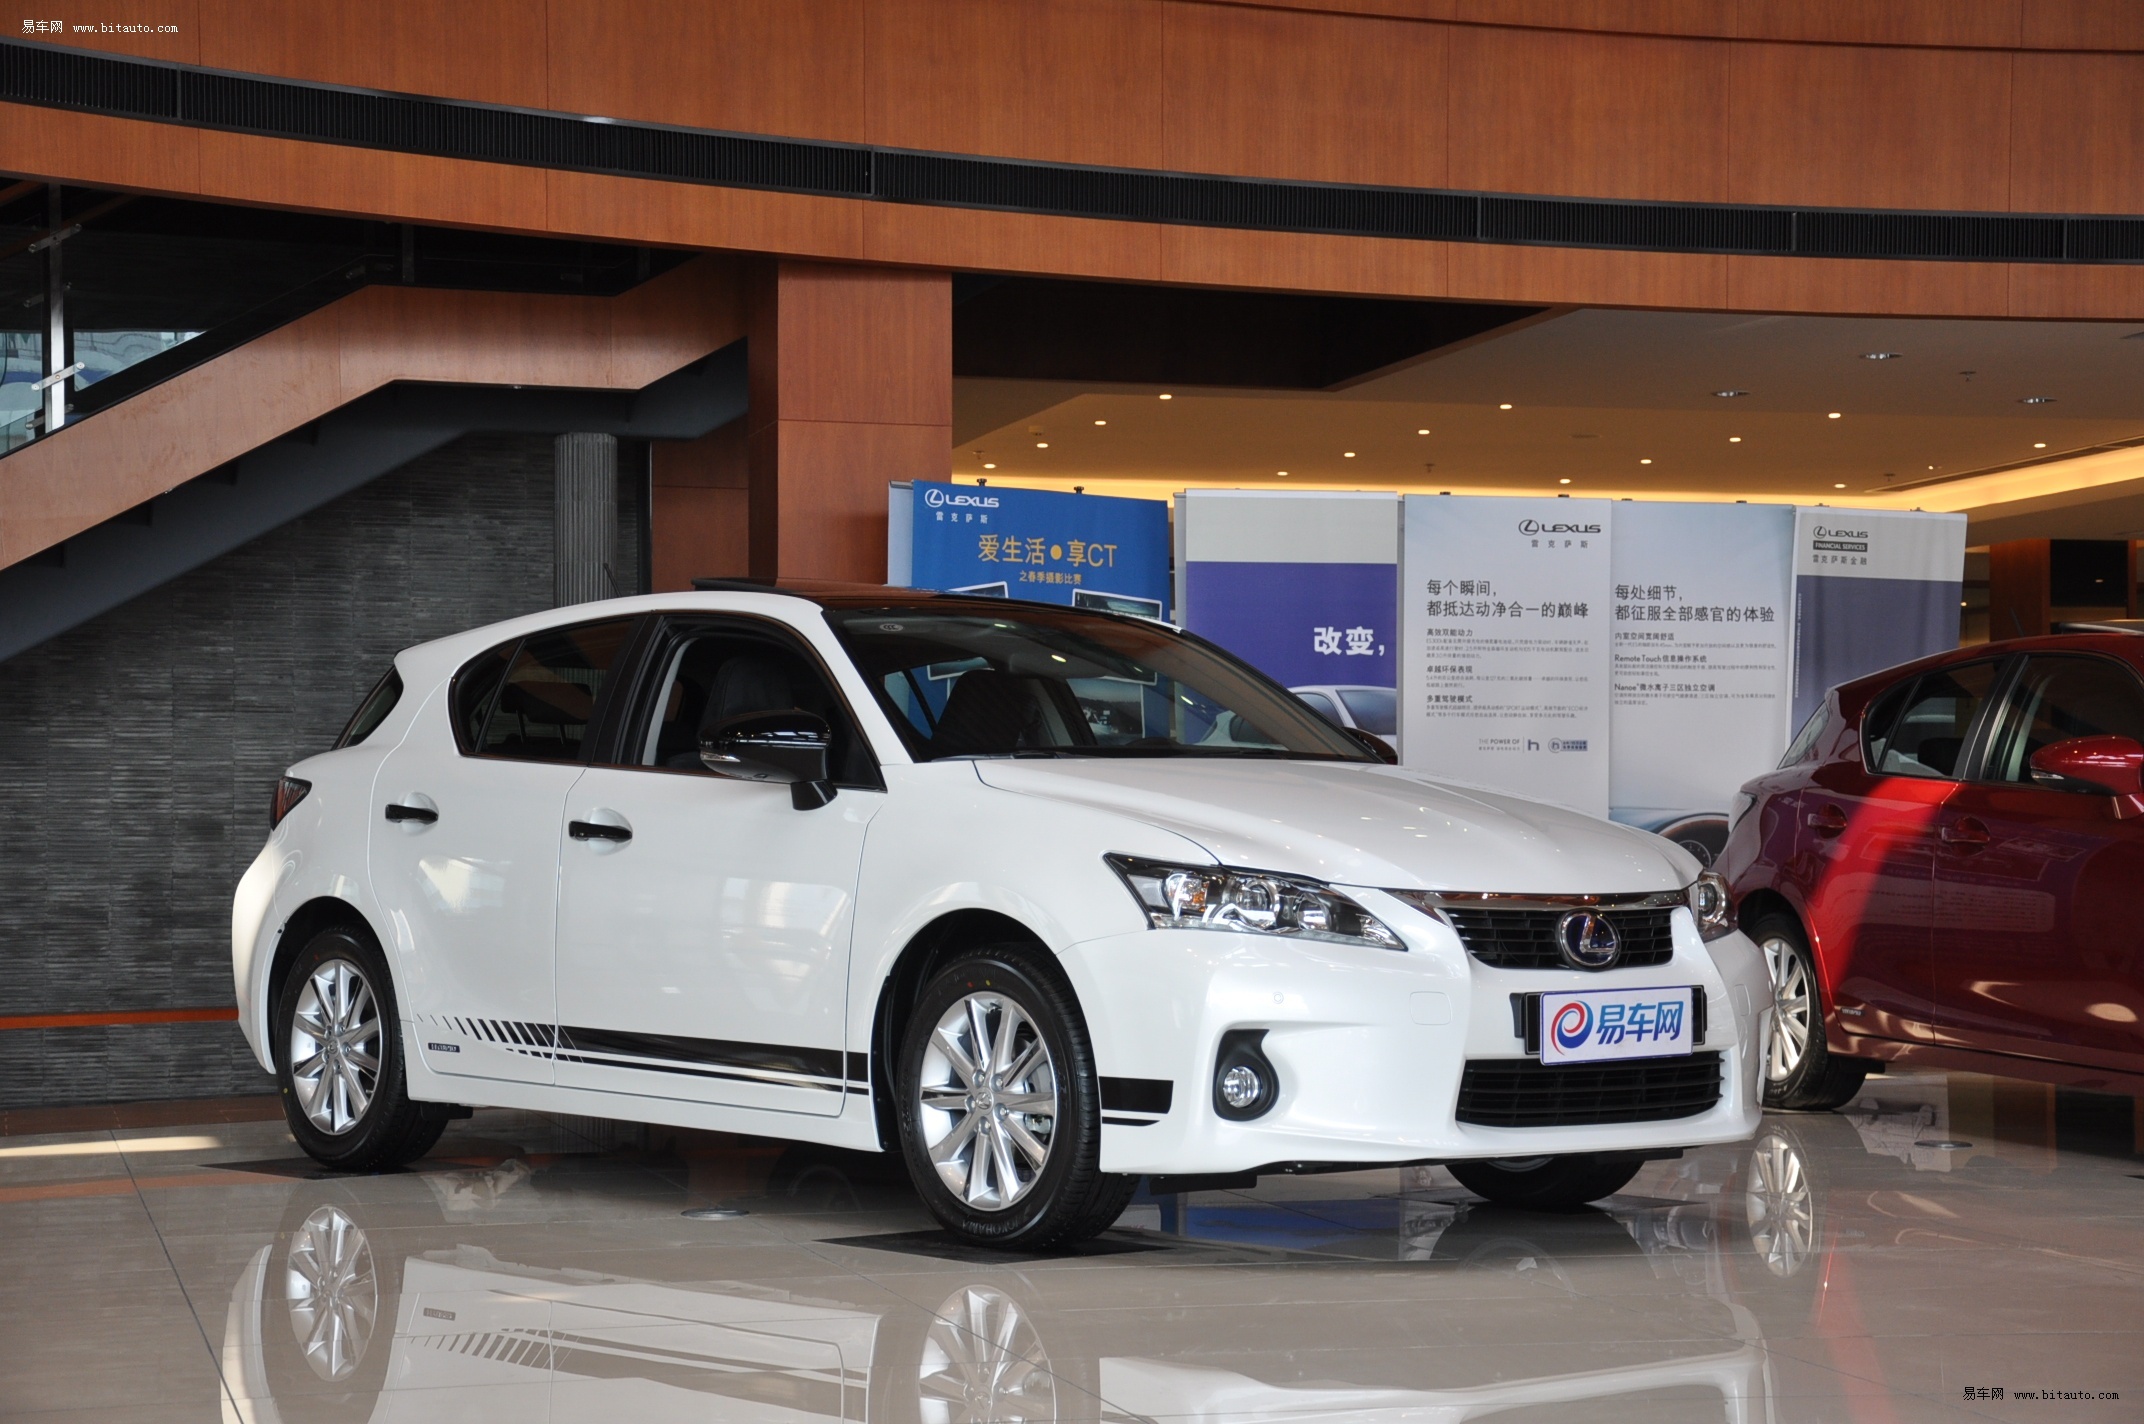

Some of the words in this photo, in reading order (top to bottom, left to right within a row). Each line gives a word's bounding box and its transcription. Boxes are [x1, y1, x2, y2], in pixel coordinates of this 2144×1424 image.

[945, 494, 1000, 508] LEXUS
[935, 511, 989, 524] 雷克萨斯
[1541, 523, 1602, 534] LEXUS
[1828, 529, 1868, 538] LEXUS
[1531, 539, 1589, 549] 雷克萨斯
[1815, 542, 1843, 551] FINANCIAL
[1843, 543, 1866, 552] SERVICES
[1812, 554, 1868, 566] 雷克萨斯金融
[1018, 569, 1083, 586] 之春季摄影比赛
[1426, 600, 1589, 619] 都抵达动净合一的巅峰
[1614, 604, 1776, 623] 都征服全部感官的体验
[1426, 628, 1474, 637] 高效双能动力
[1614, 654, 1641, 663] Remote
[1426, 665, 1473, 674] 卓越环保表现
[1426, 695, 1473, 704] 多重驾驶模式
[1596, 1001, 1684, 1045] 易车网
